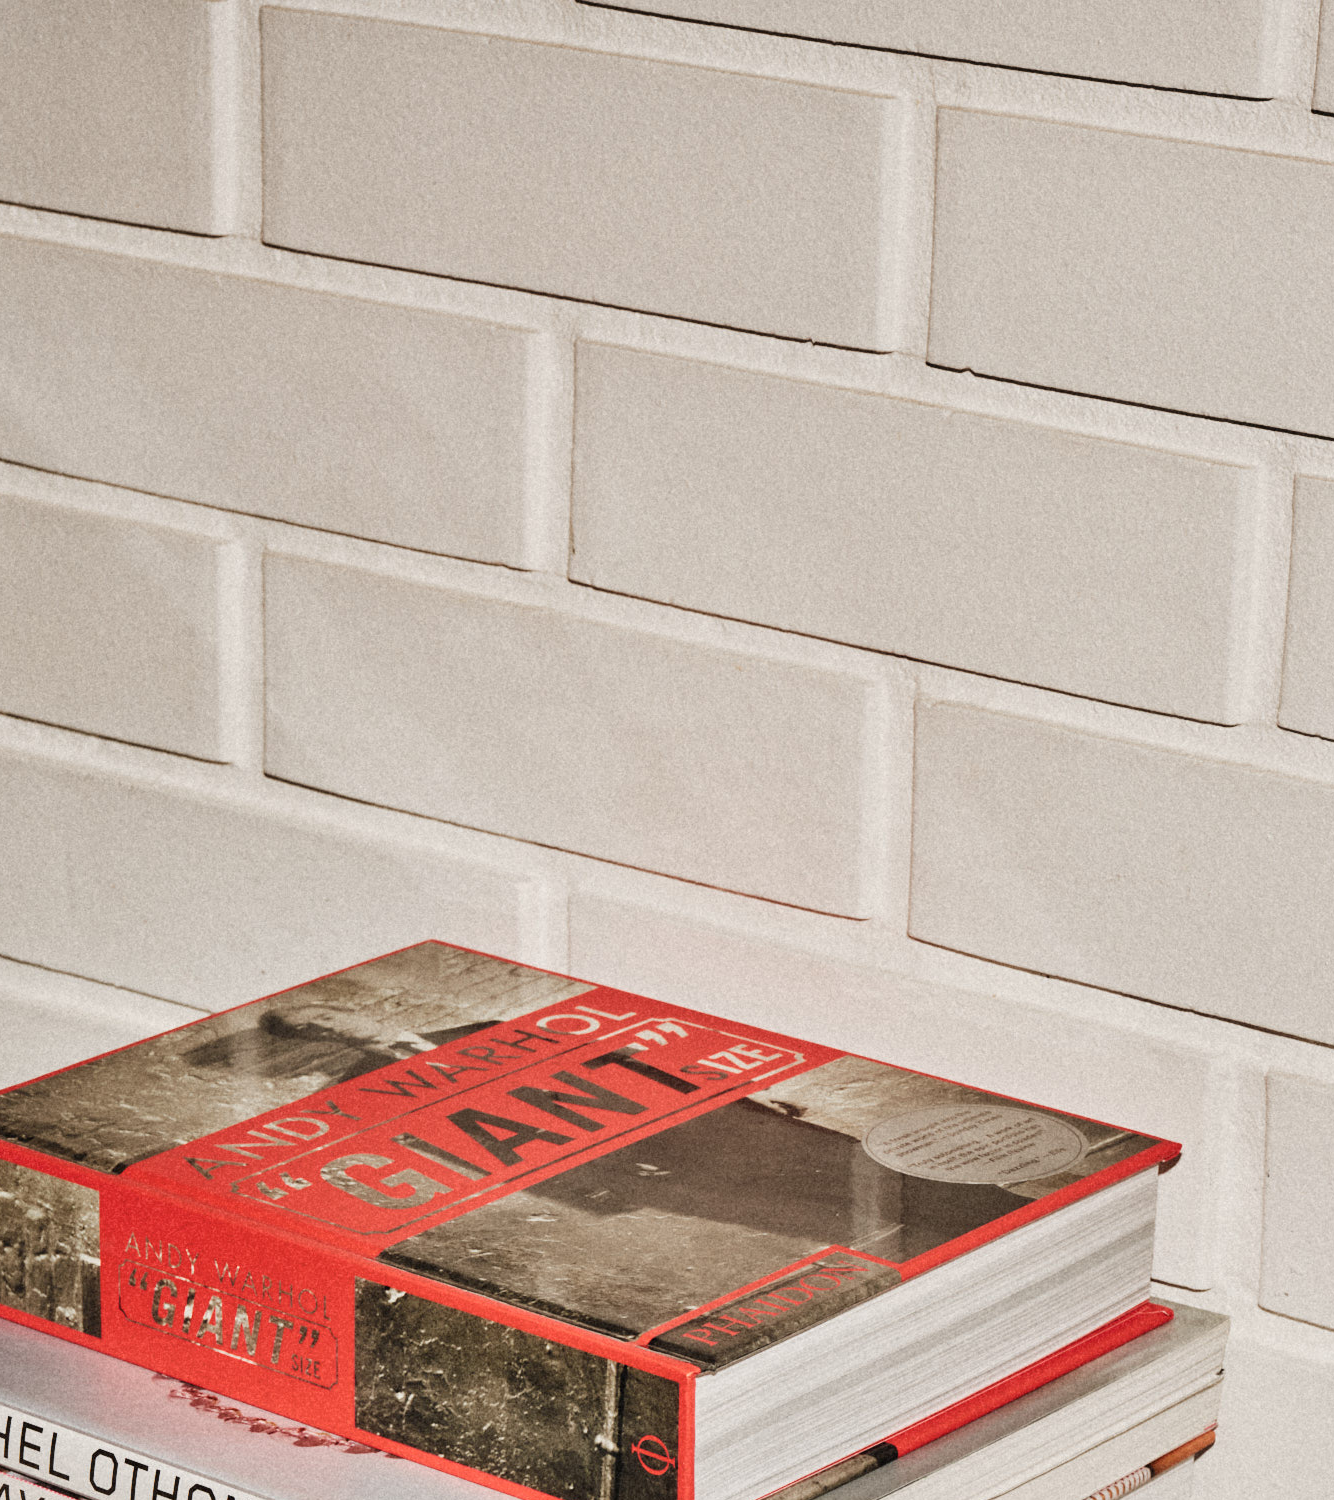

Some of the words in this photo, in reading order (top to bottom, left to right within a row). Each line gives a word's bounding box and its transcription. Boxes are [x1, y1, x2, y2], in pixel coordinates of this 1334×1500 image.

[183, 1100, 362, 1180] ANDY
[358, 1005, 637, 1100] WARHOL
[679, 1042, 784, 1083] SIZE
[125, 1232, 200, 1275] ANDY
[214, 1258, 331, 1321] WARHOL
[681, 1258, 868, 1347] PHAIDON
[291, 1353, 321, 1379] SIZE
